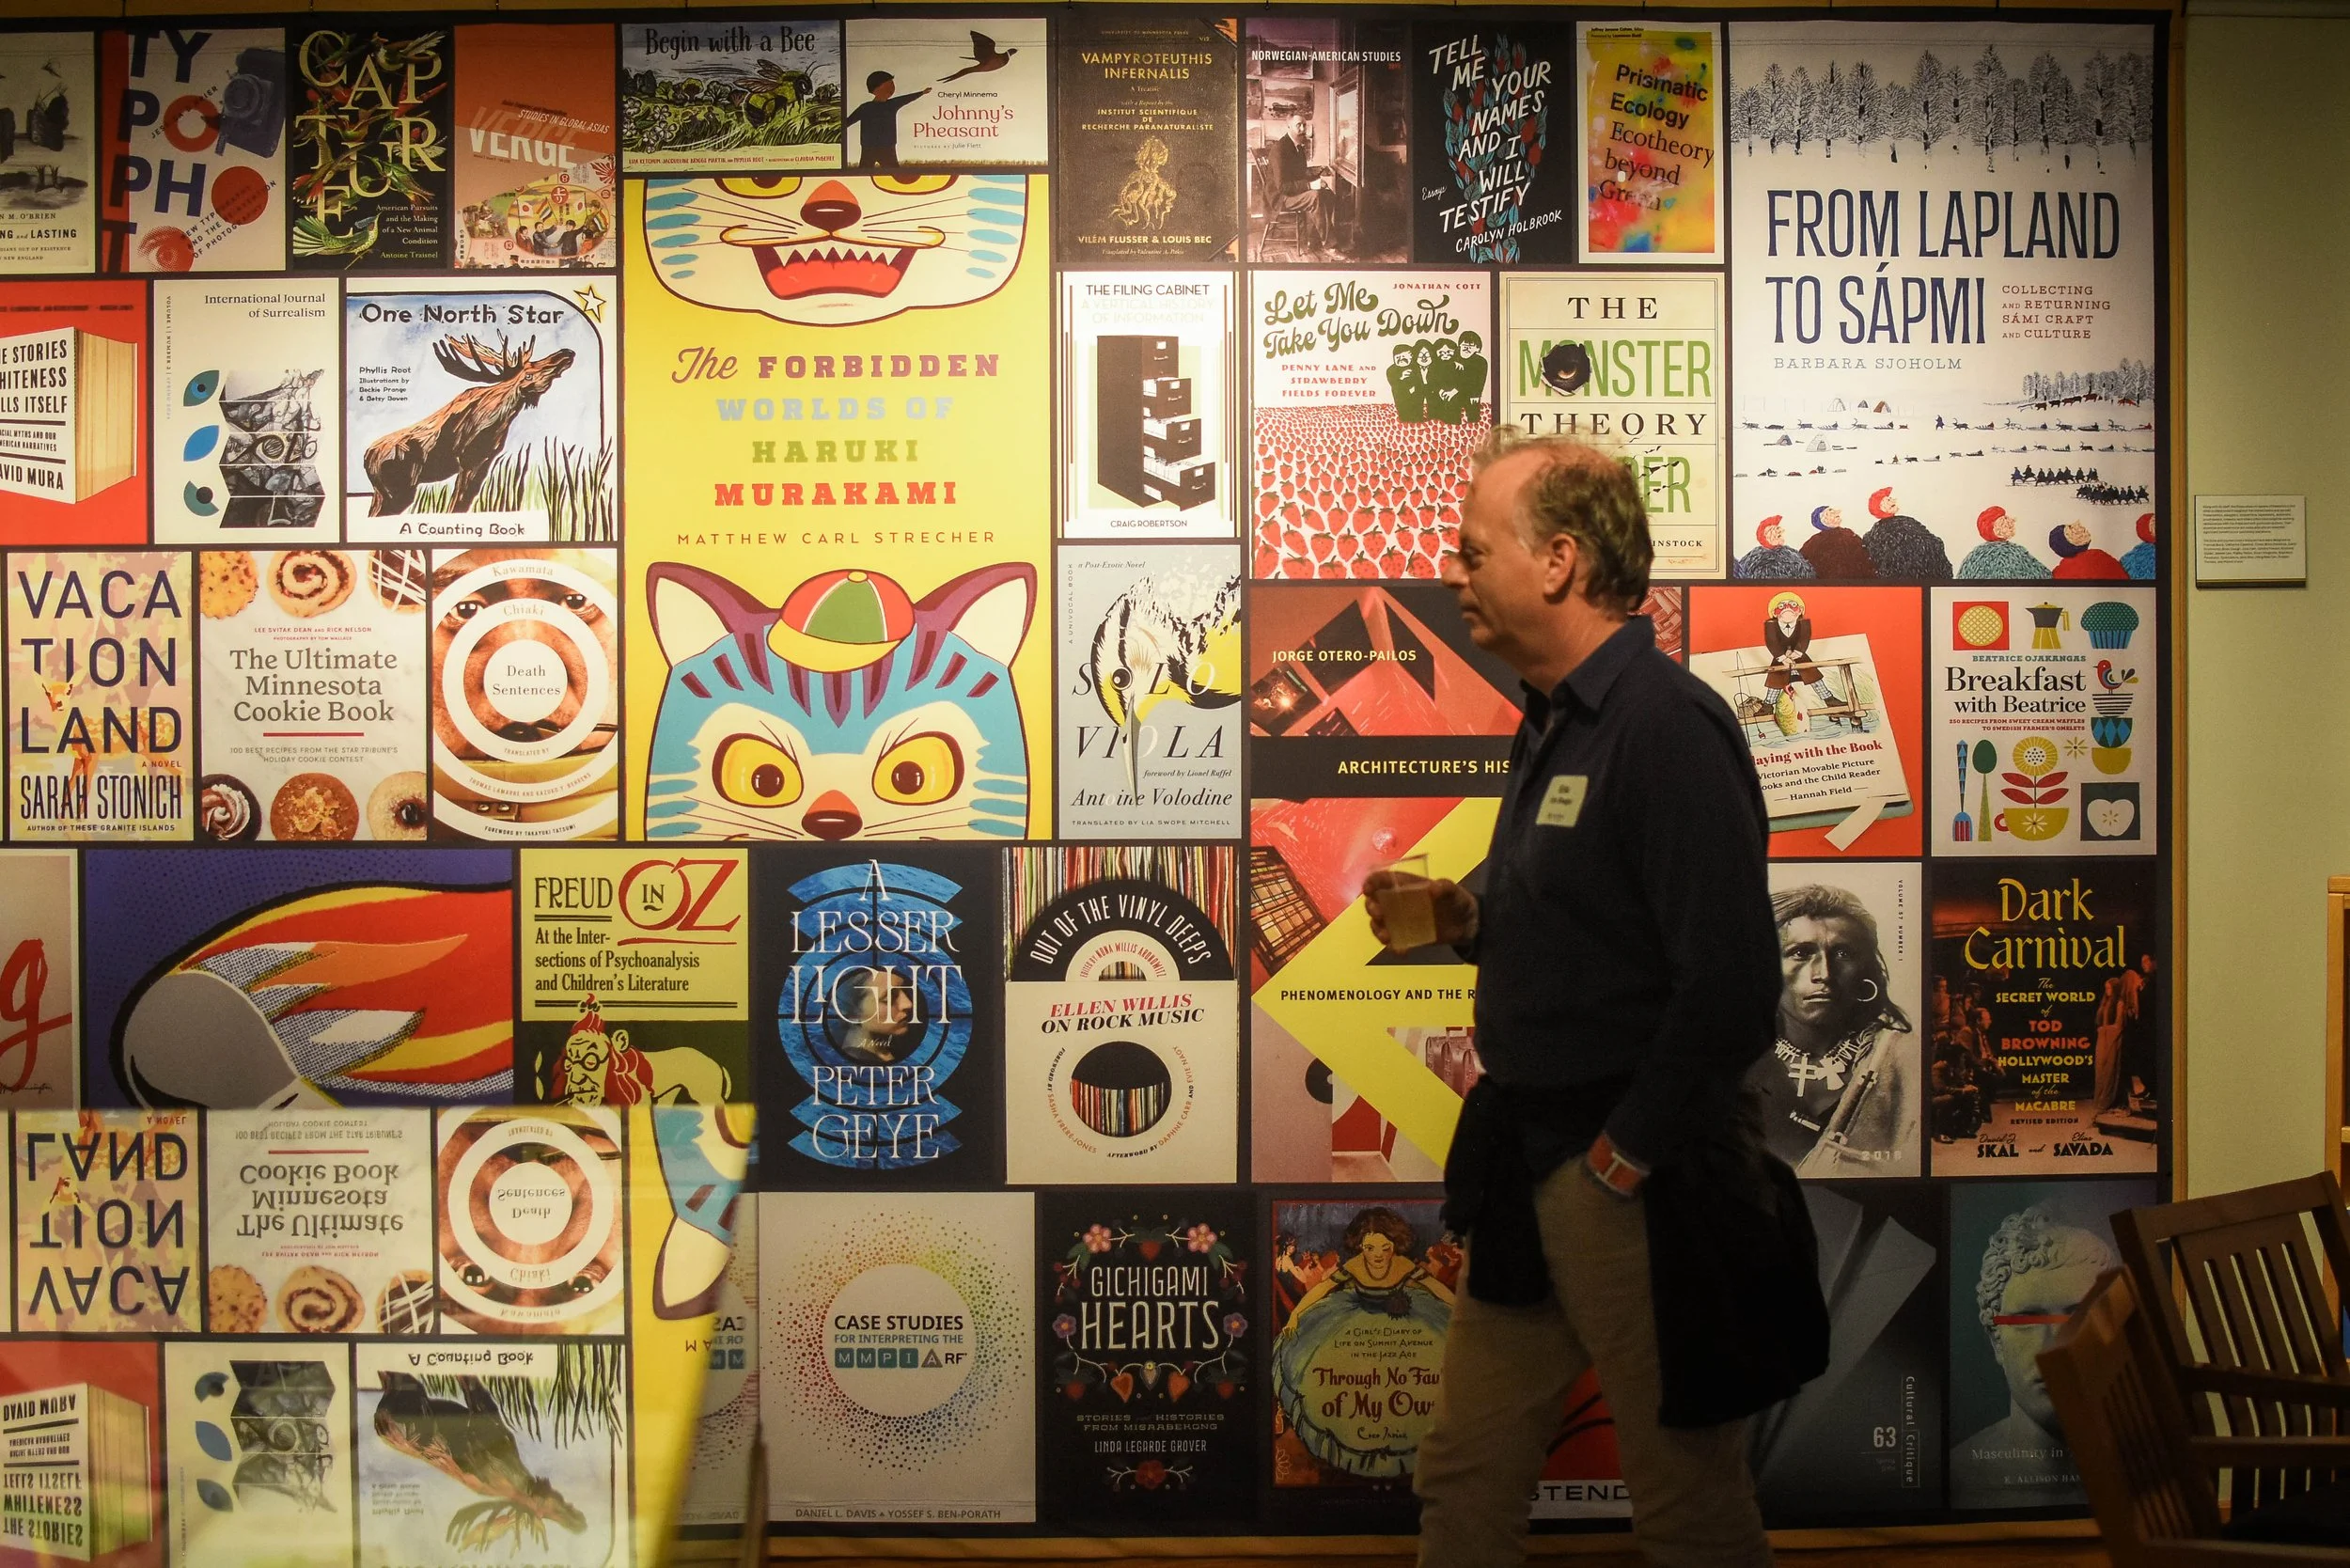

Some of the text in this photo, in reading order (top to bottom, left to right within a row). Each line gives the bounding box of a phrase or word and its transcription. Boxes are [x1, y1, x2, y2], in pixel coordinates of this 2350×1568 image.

[646, 26, 815, 60] Begin with a Bee
[1429, 34, 1482, 74] TELL
[1082, 53, 1213, 66] VAMPYROTEUTHIS
[1251, 50, 1402, 63] NORWEGIAN-AMERICAN STUDIES
[1104, 68, 1189, 79] INFERNALIS
[1452, 55, 1485, 91] ME
[1492, 60, 1551, 101] YOUR
[1616, 63, 1708, 102] Prismatic
[938, 91, 962, 101] Cheryl
[518, 108, 610, 134] STUDIES IN GLOBAL ASIAS
[932, 104, 1014, 124] Johnny's
[1472, 90, 1544, 136] NAMES
[1610, 92, 1689, 130] Ecology
[914, 122, 998, 138] Pheasant
[1458, 132, 1521, 162] AND I
[1609, 120, 1715, 168] Ecotheory
[1479, 160, 1525, 195] WILL
[1605, 148, 1681, 186] beyond
[376, 204, 438, 212] American Pursuits
[1439, 182, 1530, 233] TESTIFY
[30, 229, 77, 239] LASTING
[1455, 210, 1562, 253] CAROLYN HOLBROOK
[1767, 189, 2120, 259] FROM LAPLAND
[1078, 233, 1212, 244] VILÉM FLUSSER & LOUIS BEC
[1086, 284, 1210, 296] THE FILING CABINET
[1393, 282, 1482, 291] JONATHAN COTT
[2002, 285, 2093, 295] COLLECTING
[205, 293, 325, 305] International Journal
[1263, 280, 1379, 328] Let Me
[1567, 297, 1658, 319] THE
[1766, 262, 1985, 344] TO SÁPMI
[2024, 300, 2111, 310] RETURNING
[249, 307, 325, 318] of Surrealism
[360, 303, 564, 325] One North Star
[2002, 312, 2093, 324] SÁMI CRAFT
[1262, 294, 1460, 360] Take You Down
[12, 339, 67, 364] STORIES
[359, 366, 412, 376] Phyllis Root
[672, 346, 998, 384] The FORBIDDEN
[1519, 338, 1712, 398] MNSTER
[1774, 358, 1962, 369] BARBARA SJOHOLM
[25, 396, 68, 414] ITSELF
[716, 397, 954, 421] WORLDS OF
[1520, 413, 1708, 436] THEORY
[752, 439, 918, 463] HARUKI
[28, 467, 64, 490] MURA
[714, 481, 956, 506] MURAKAMI
[1137, 519, 1188, 528] ROBERTSON
[678, 530, 995, 545] MATTHEW CARL STRECHER
[18, 570, 182, 619] VACA
[21, 637, 176, 687] TION
[230, 647, 398, 670] The Ultimate
[1272, 649, 1417, 663] JORGE OTERO-PAILOS
[507, 664, 546, 677] Death
[1944, 666, 2087, 693] Breakfast
[245, 673, 383, 696] Minnesota
[493, 682, 561, 696] Sentences
[234, 699, 395, 722] Cookie Book
[21, 706, 182, 753] LAND
[1793, 740, 1883, 761] with the Book
[1338, 760, 1478, 775] ARCHITECTURE'S
[21, 775, 181, 820] SARAH STONICH
[1152, 787, 1232, 807] Volodine
[1790, 785, 1852, 802] Hannah Field
[858, 858, 889, 902] A
[534, 857, 741, 933] FREUD IN OZ
[1998, 878, 2094, 923] Dark
[790, 910, 961, 953] LESSER
[1029, 894, 1213, 965] OUT OF THE VINYL DEEPS
[1964, 925, 2126, 971] Carnival
[535, 950, 700, 971] sections of Psychoanalysis
[535, 972, 689, 992] and Children's Literature
[791, 964, 964, 1025] LIGHT
[1050, 993, 1193, 1018] ELLEN WILLIS
[1281, 989, 1463, 1001] PHENOMENOLOGY AND THE
[1041, 1008, 1205, 1034] ON ROCK MUSIC
[812, 1065, 939, 1106] PETER
[812, 1113, 940, 1160] GEYE
[1978, 1142, 2114, 1158] SKAL SAVADA
[1091, 1266, 1209, 1296] GICHIGAMI
[835, 1315, 964, 1330] CASE STUDIES
[1081, 1300, 1219, 1349] HEARTS
[835, 1335, 964, 1343] FOR INTERPRETING THE
[1312, 1366, 1407, 1389] Through No
[1873, 1427, 1897, 1448] 63
[1905, 1376, 1916, 1483] Cultural Critique
[1094, 1440, 1207, 1452] LINDA LEGARDE GROVER
[1972, 1447, 2063, 1461] Masculinity in
